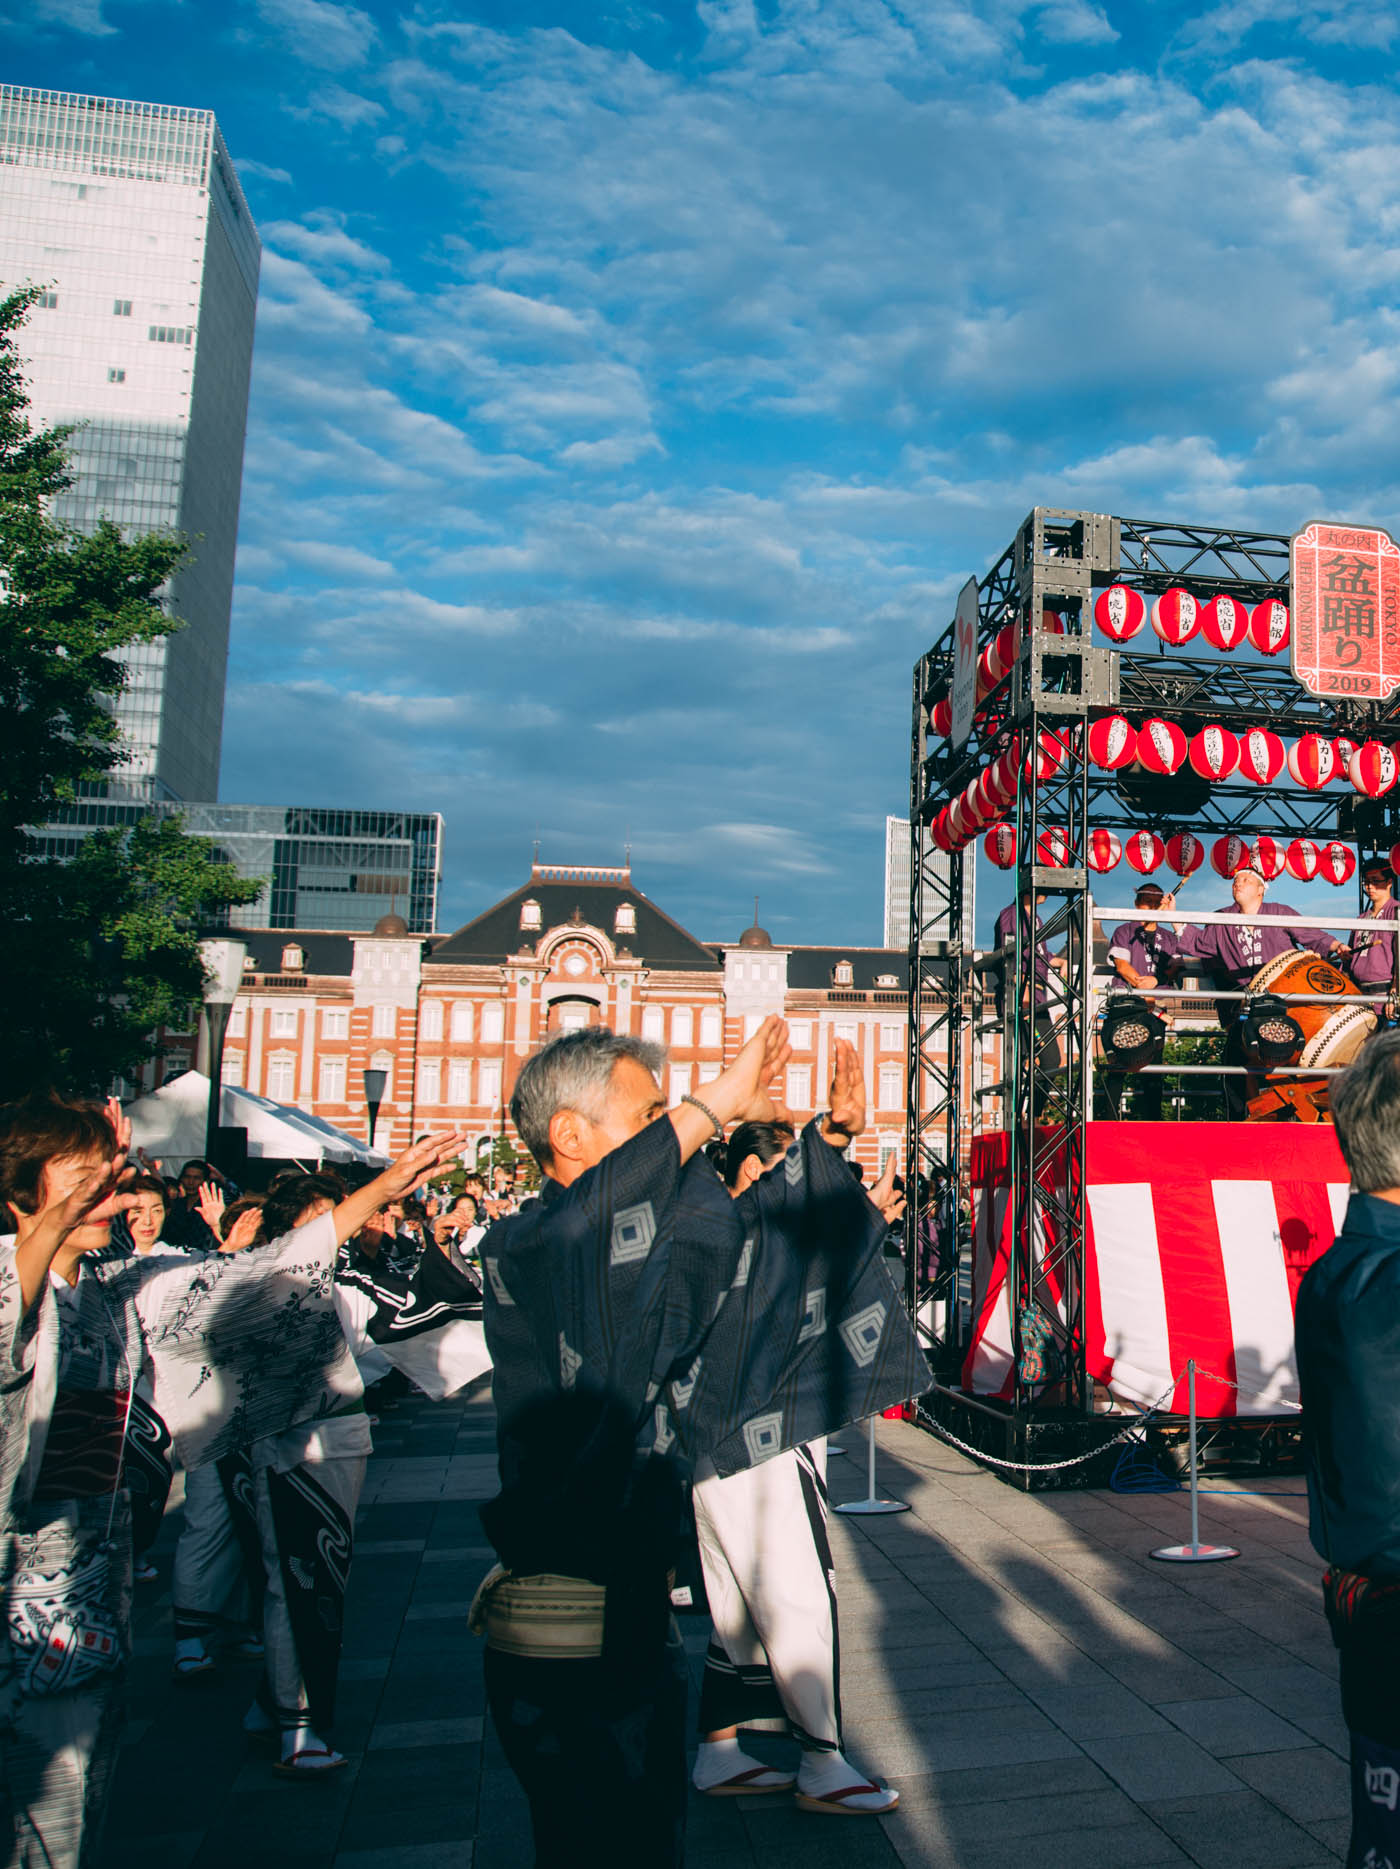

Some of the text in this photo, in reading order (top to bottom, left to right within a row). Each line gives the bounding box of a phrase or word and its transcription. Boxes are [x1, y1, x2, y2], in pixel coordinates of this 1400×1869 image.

[1326, 531, 1371, 549] 丸の内
[1270, 603, 1285, 639] 東京都
[1300, 561, 1313, 654] MARUNOUCHI
[1321, 554, 1376, 667] 盆踊り
[1384, 585, 1398, 646] TOKYO
[1328, 676, 1371, 692] 2019
